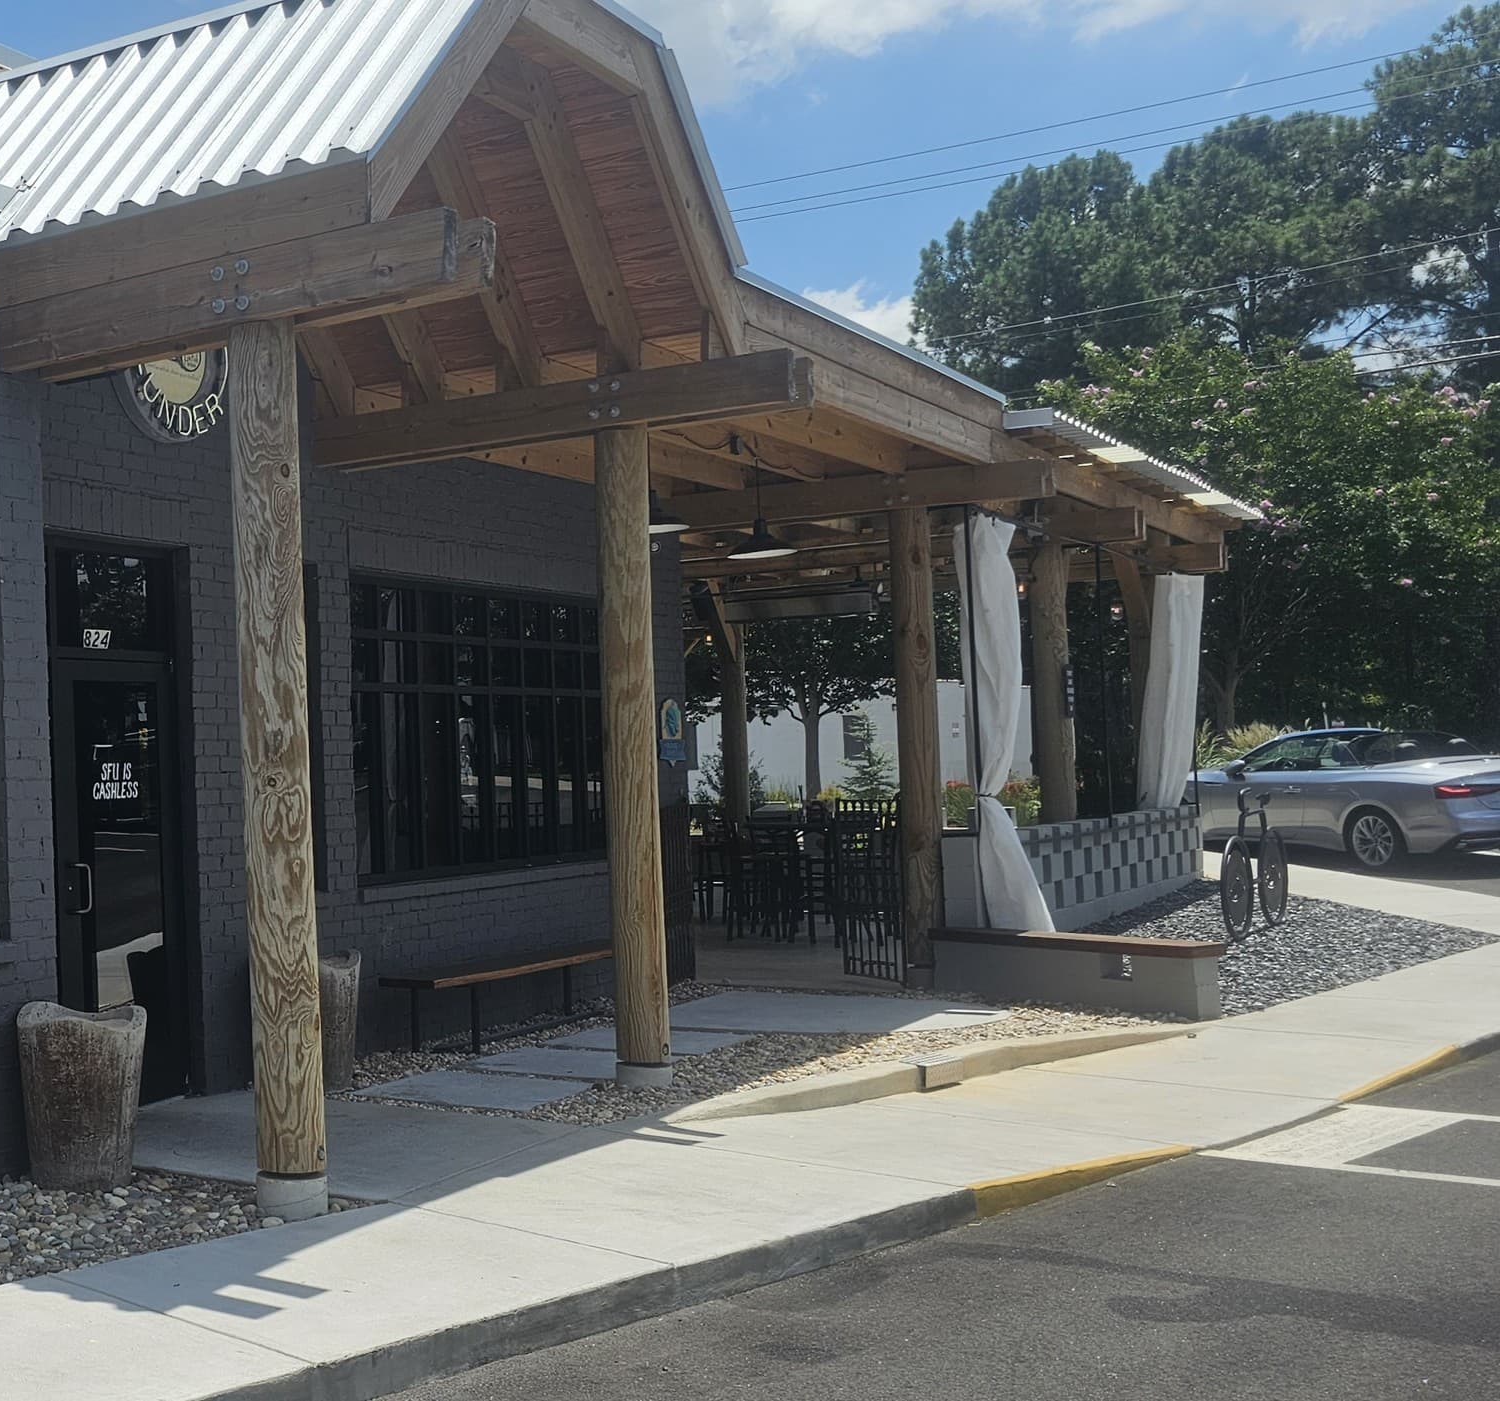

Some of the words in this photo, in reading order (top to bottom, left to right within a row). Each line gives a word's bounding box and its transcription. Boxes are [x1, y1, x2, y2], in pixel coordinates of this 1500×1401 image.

[143, 372, 224, 436] UNDER
[84, 630, 110, 648] 824
[100, 762, 120, 781] SFU
[122, 762, 132, 781] IS
[92, 781, 139, 801] CASHLESS
